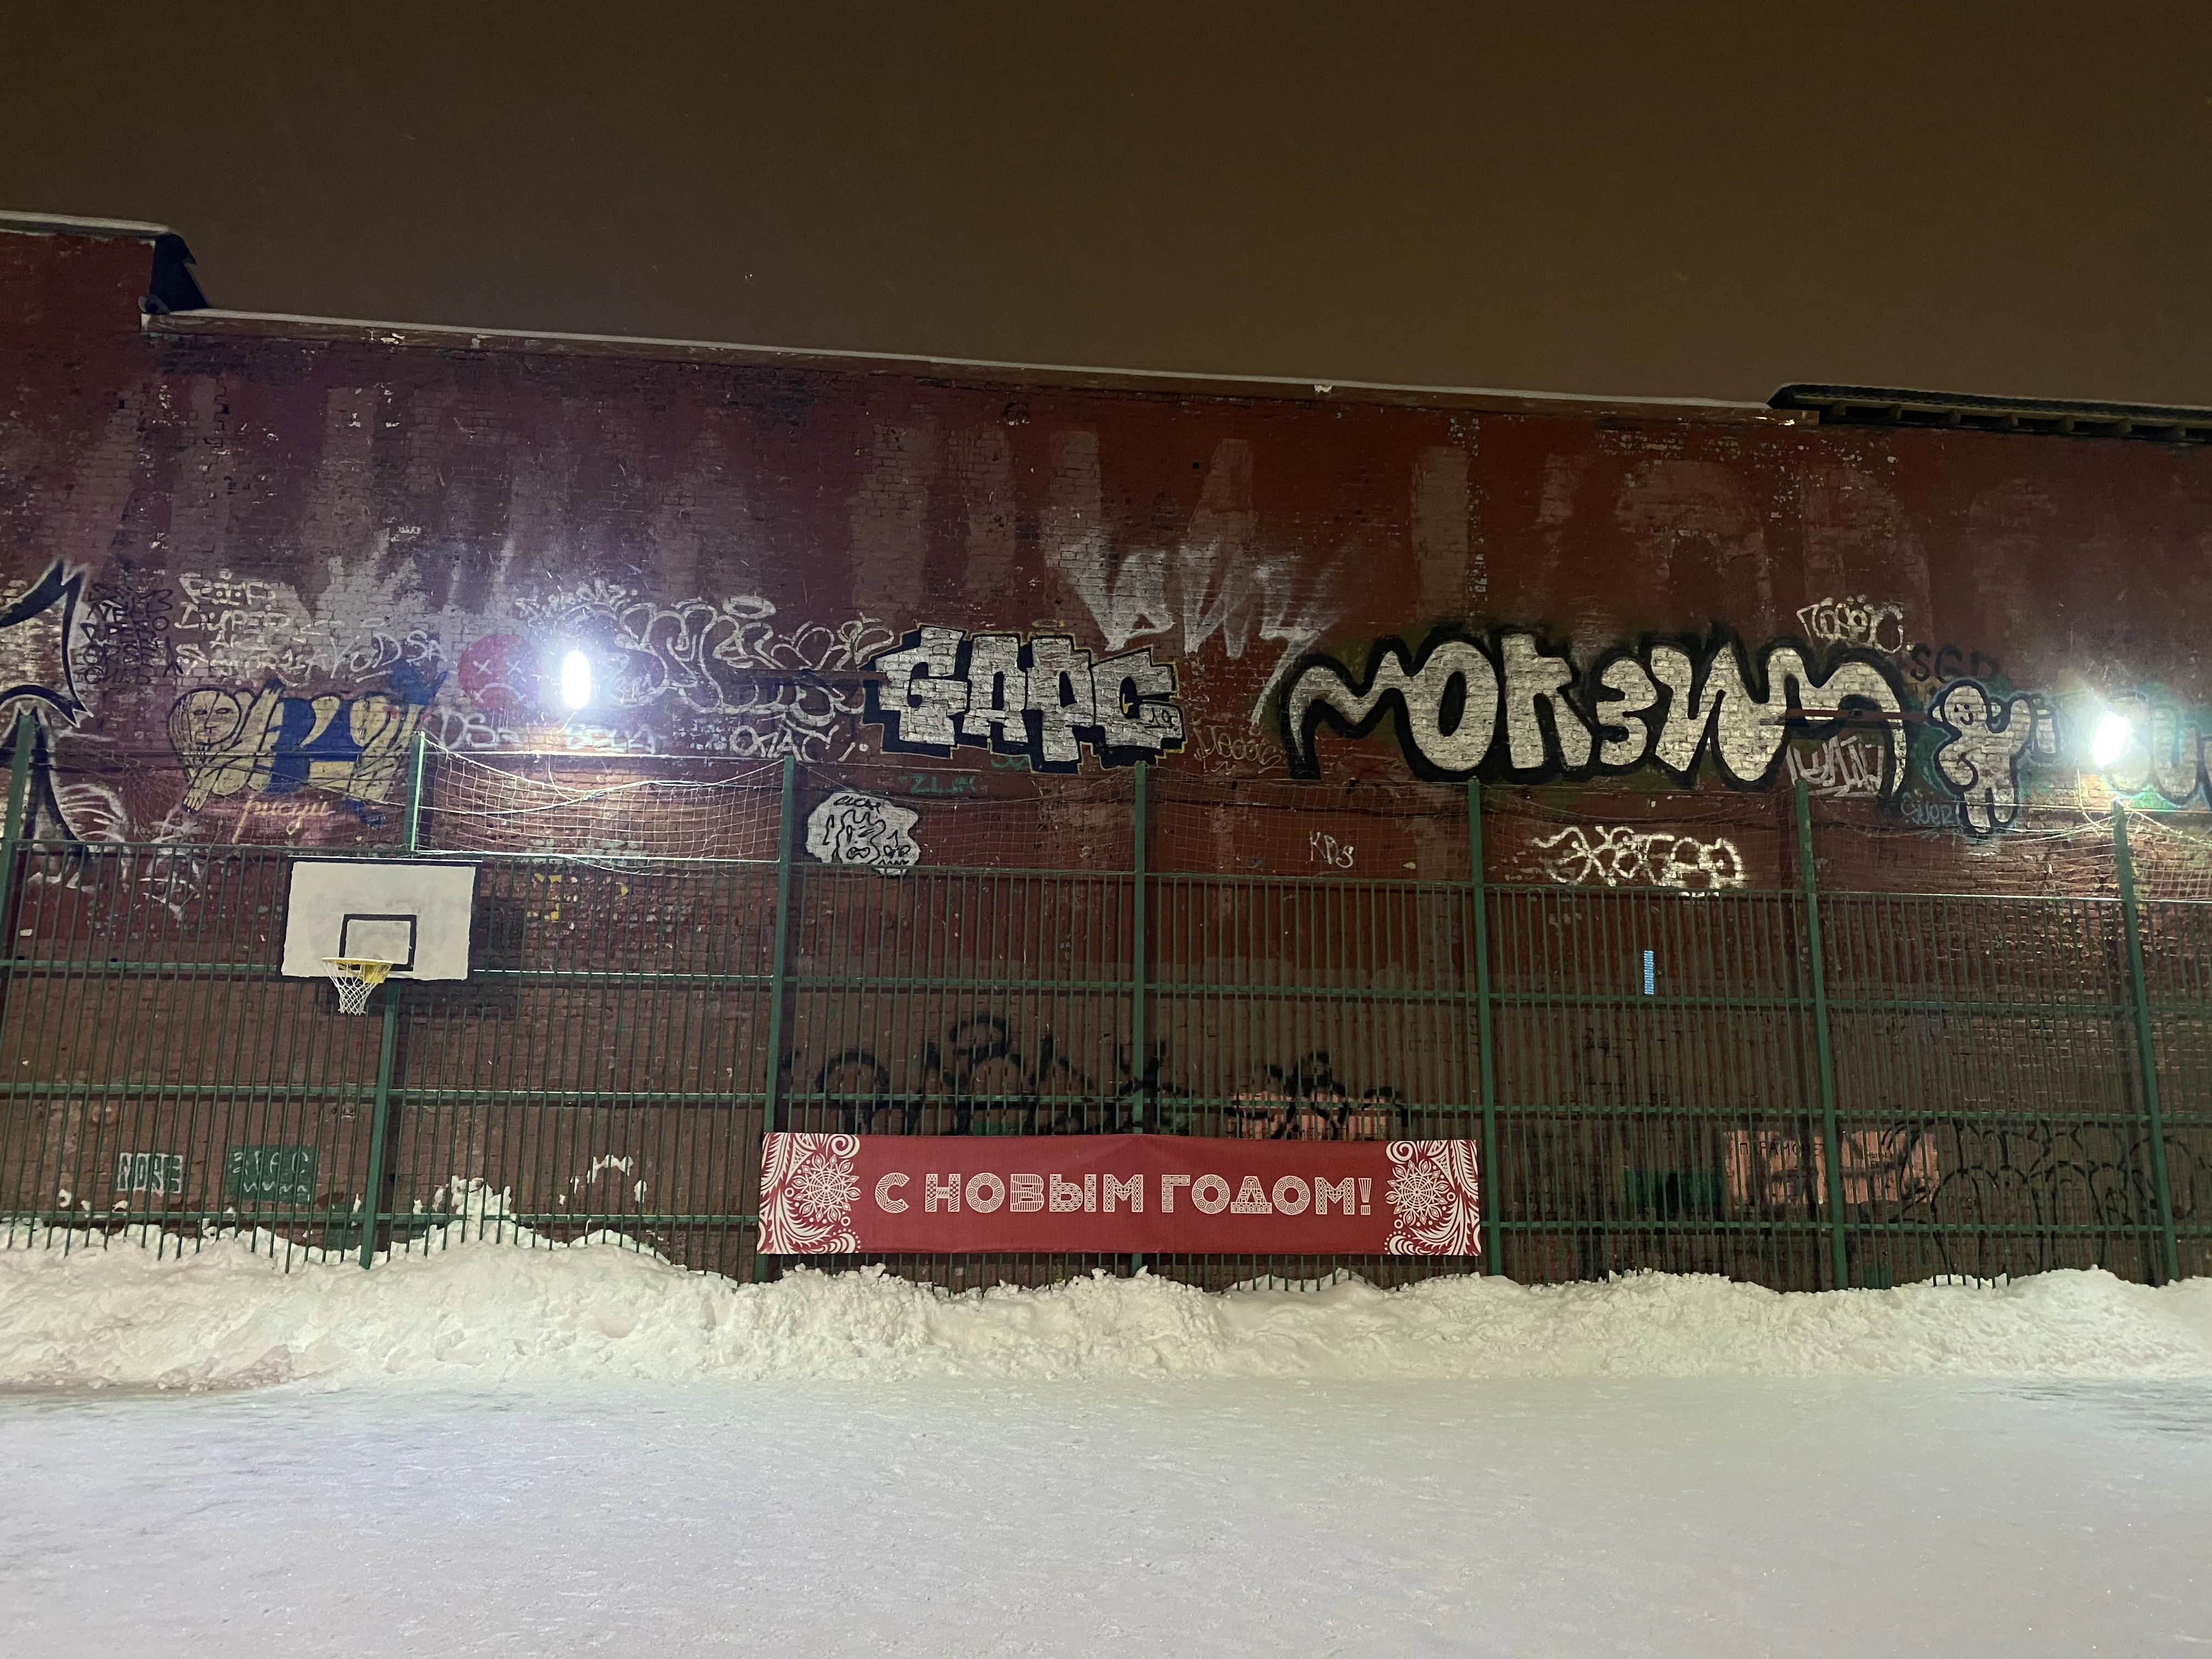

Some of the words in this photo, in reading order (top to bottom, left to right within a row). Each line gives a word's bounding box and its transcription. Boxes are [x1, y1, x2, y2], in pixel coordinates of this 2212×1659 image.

[874, 1172, 910, 1214] С
[924, 1172, 1144, 1214] НОВЫМ
[1161, 1174, 1372, 1215] ГОДОМ!
